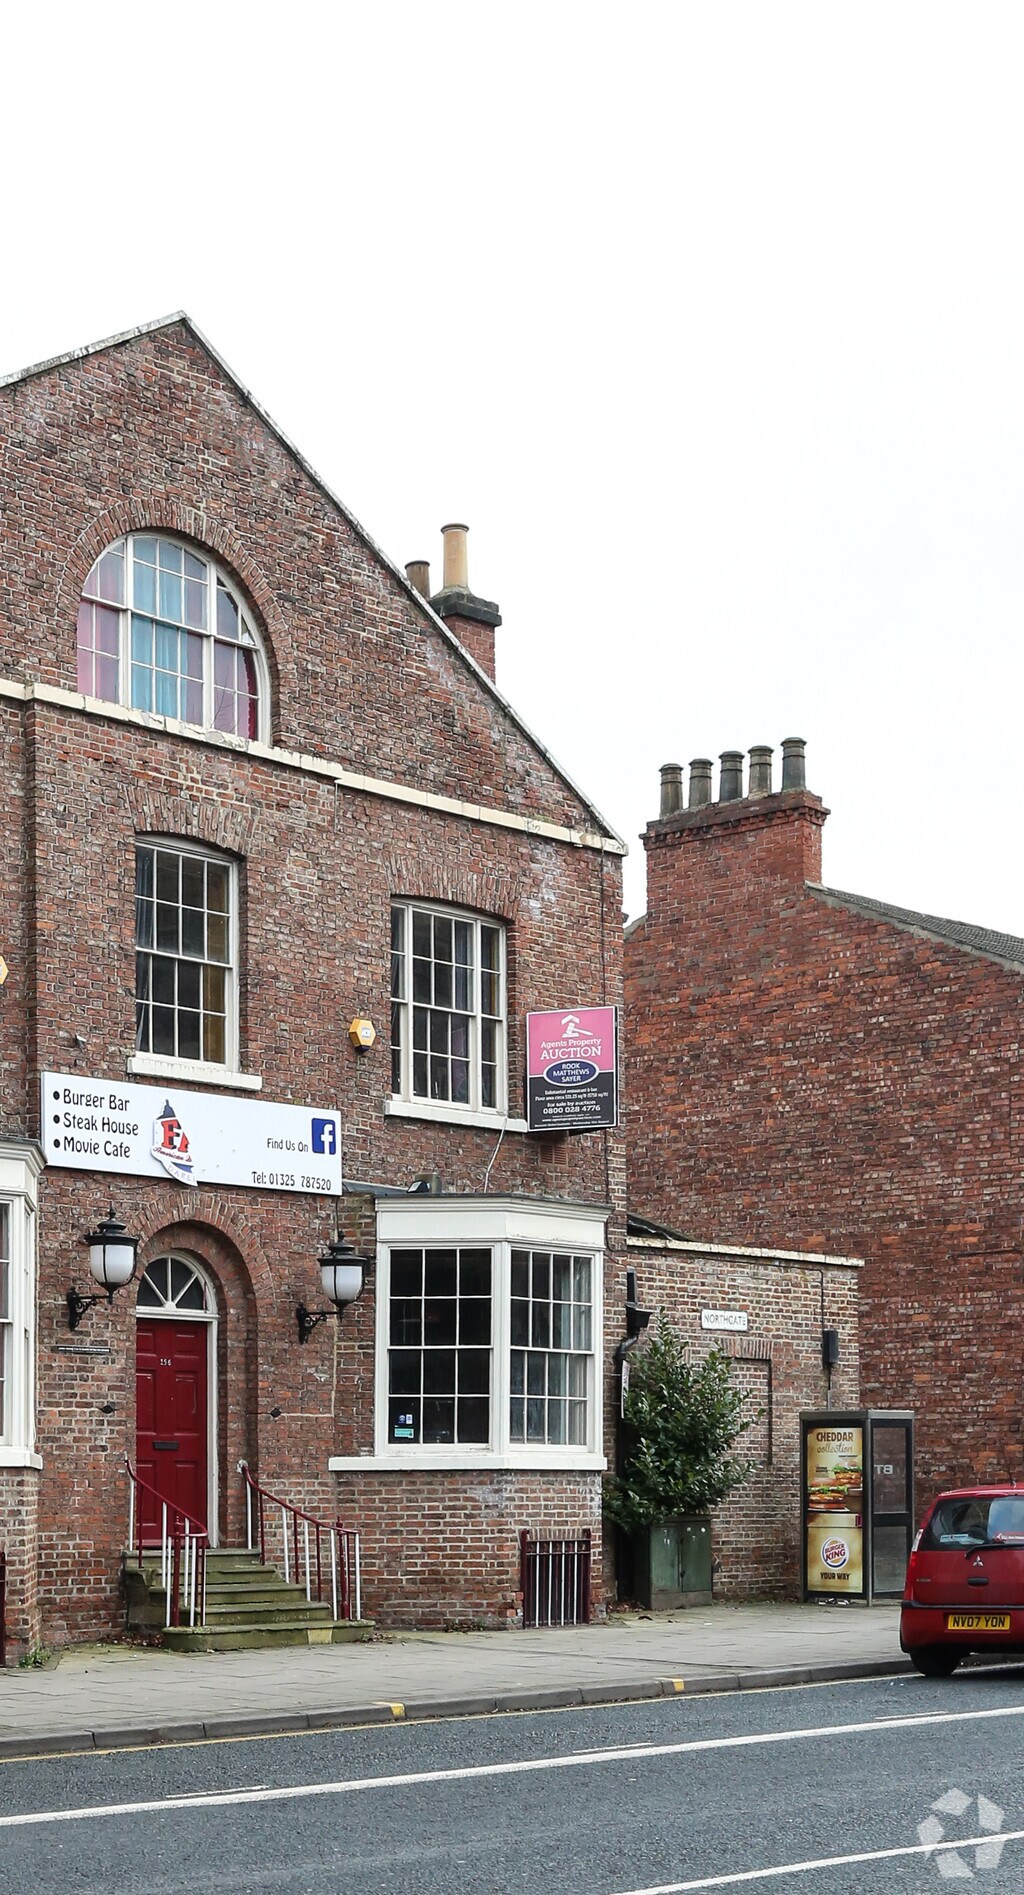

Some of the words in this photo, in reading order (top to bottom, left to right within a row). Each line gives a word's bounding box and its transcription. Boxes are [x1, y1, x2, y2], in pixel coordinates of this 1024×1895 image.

[541, 1041, 567, 1049] Agents
[540, 1046, 601, 1060] AUCTION
[64, 1088, 104, 1108] Burger
[109, 1094, 130, 1111] Bar
[63, 1112, 97, 1131] Steak
[102, 1117, 138, 1136] House
[64, 1136, 99, 1154] Movie
[104, 1140, 130, 1158] Cafe
[267, 1138, 283, 1150] Find
[286, 1140, 295, 1151] Us
[298, 1142, 308, 1152] On
[252, 1171, 266, 1184] Tel:
[269, 1173, 295, 1186] 01325
[301, 1176, 331, 1191] 787520
[704, 1314, 745, 1325] NORTHGATE
[817, 1432, 853, 1442] CHEDDAR
[817, 1442, 852, 1453] collection
[825, 1544, 845, 1554] BURGER
[826, 1549, 846, 1560] KING
[953, 1617, 981, 1627] NV07
[984, 1617, 1005, 1627] YON
